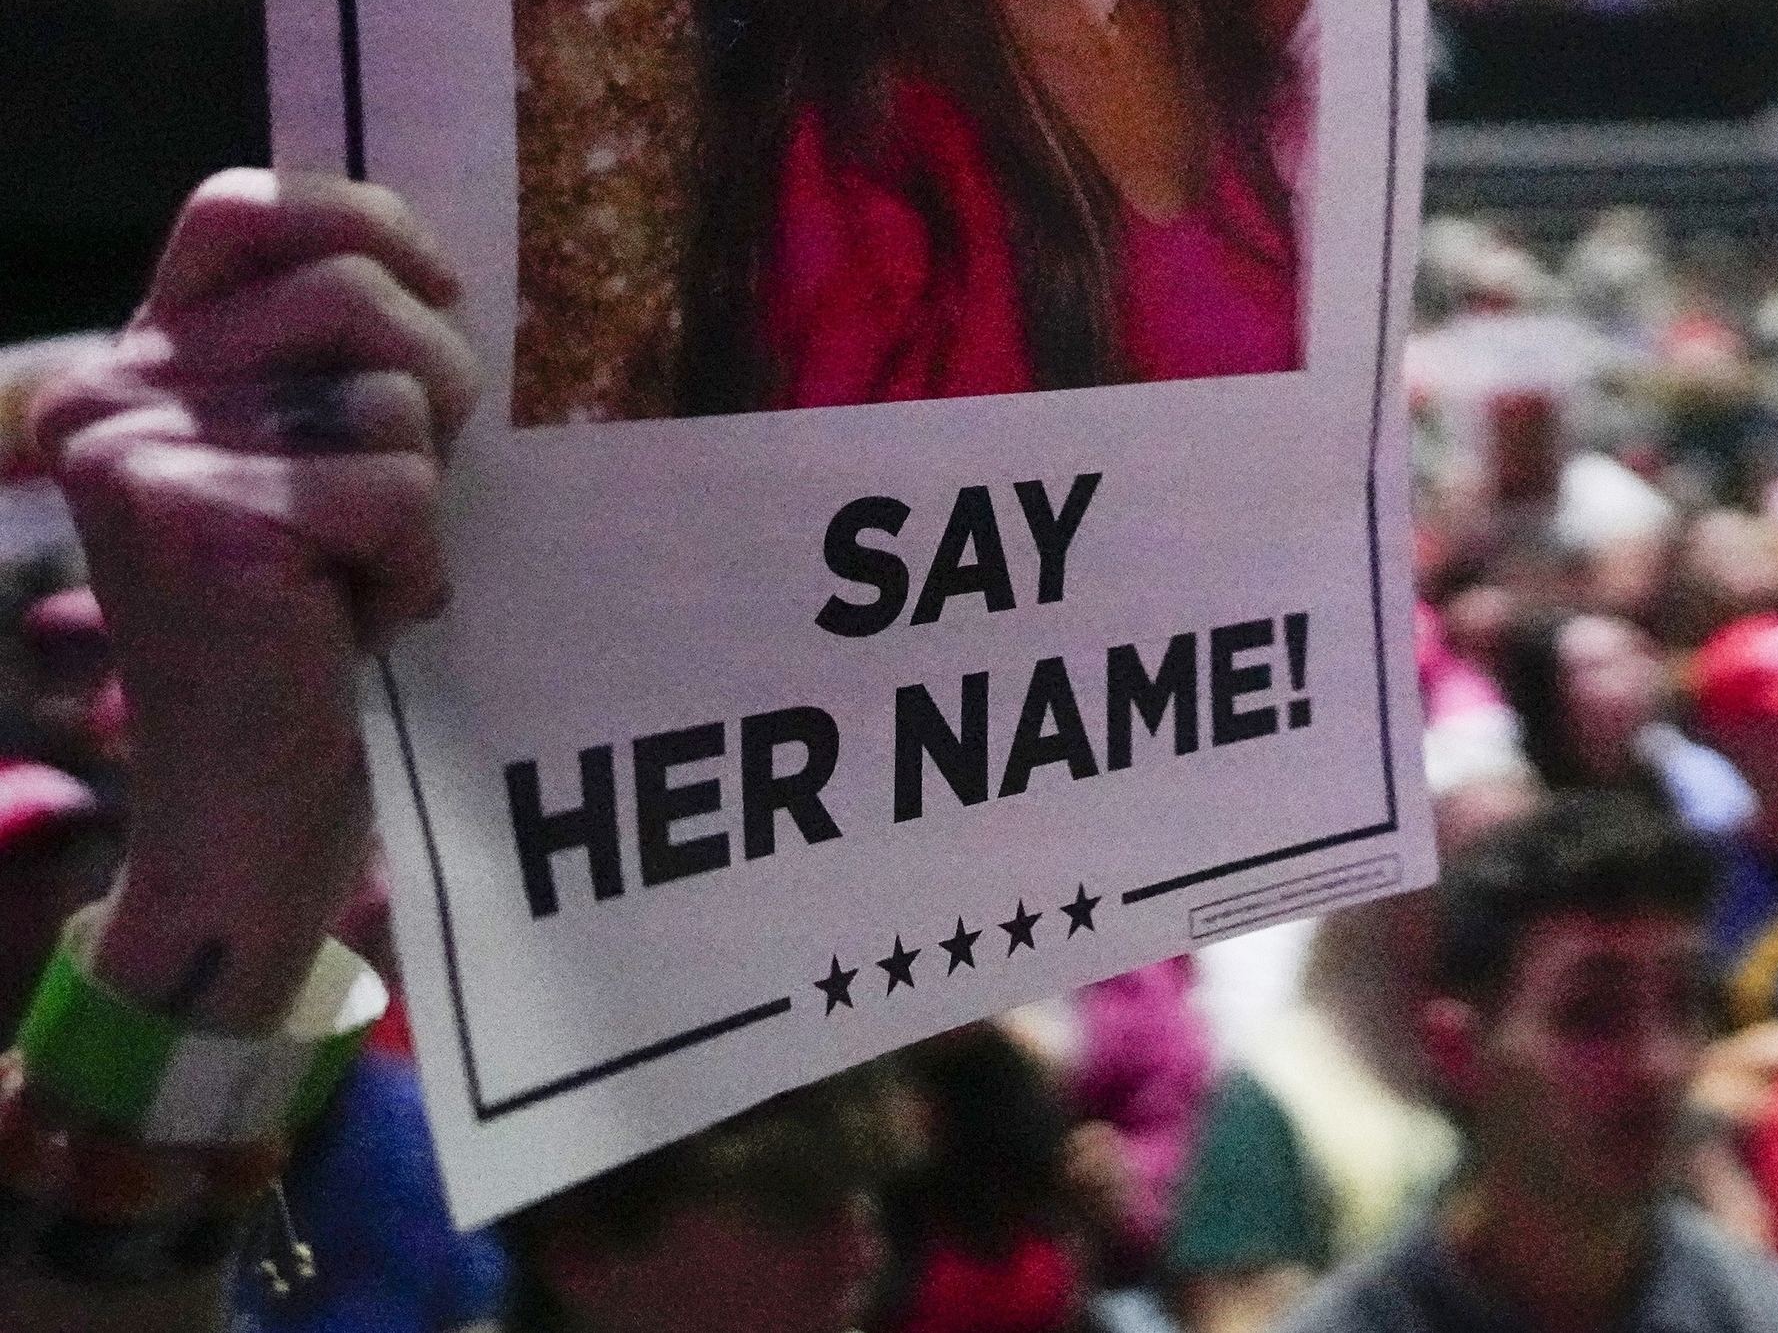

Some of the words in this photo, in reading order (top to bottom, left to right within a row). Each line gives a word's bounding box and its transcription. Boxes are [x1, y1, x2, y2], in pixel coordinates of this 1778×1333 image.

[812, 471, 1103, 638] SAY
[503, 704, 843, 920] HER
[892, 612, 1312, 824] NAME!
